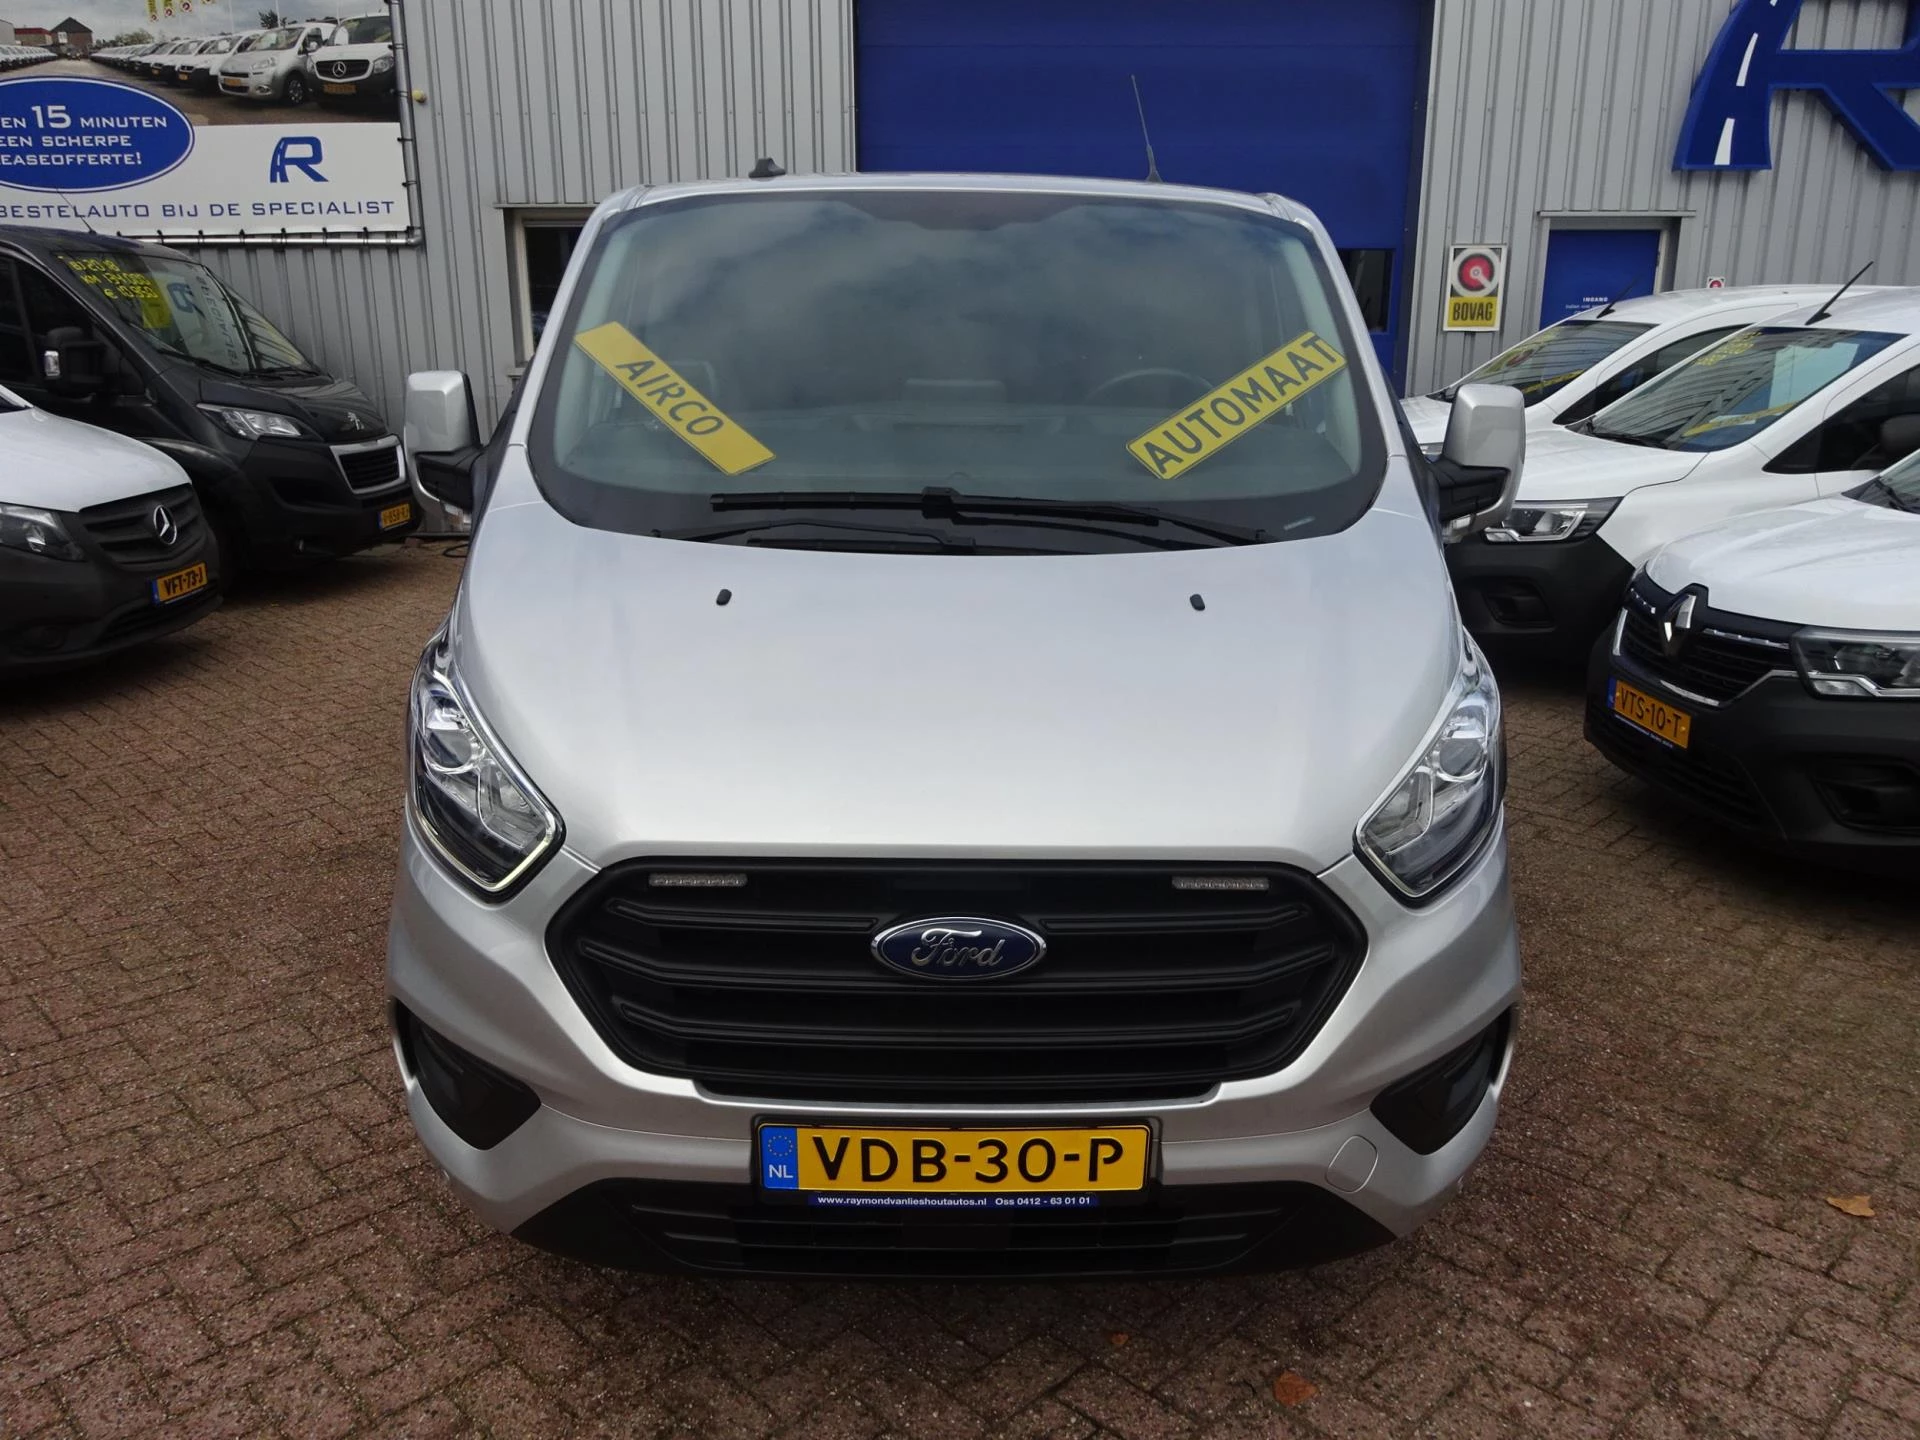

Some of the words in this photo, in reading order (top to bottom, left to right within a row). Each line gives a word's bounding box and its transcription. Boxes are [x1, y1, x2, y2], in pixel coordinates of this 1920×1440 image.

[31, 105, 72, 128] 15
[80, 117, 168, 128] MINUTEN
[0, 135, 32, 147] EEN
[42, 135, 132, 147] SCHERPE
[0, 204, 149, 218] BESTELAUTO
[162, 204, 198, 217] BIJ
[210, 203, 241, 217] DE
[252, 201, 395, 216] SPECIALIST
[1453, 302, 1493, 321] BOVAG
[615, 359, 724, 436] AIRCO
[1143, 334, 1337, 475] AUTOMAAT
[163, 566, 204, 596] VFT-73-J
[1621, 687, 1682, 738] VTS-10-T
[911, 928, 1005, 967] Ford
[769, 1164, 794, 1179] NL
[811, 1135, 1124, 1184] VDB-30-P
[817, 1196, 987, 1206] www.raymondvanlieshoutautos.nl
[995, 1197, 1015, 1206] Oss
[1017, 1197, 1041, 1206] 0412
[1050, 1196, 1063, 1205] 63
[1065, 1196, 1076, 1205] 01
[1079, 1196, 1091, 1205] 01
